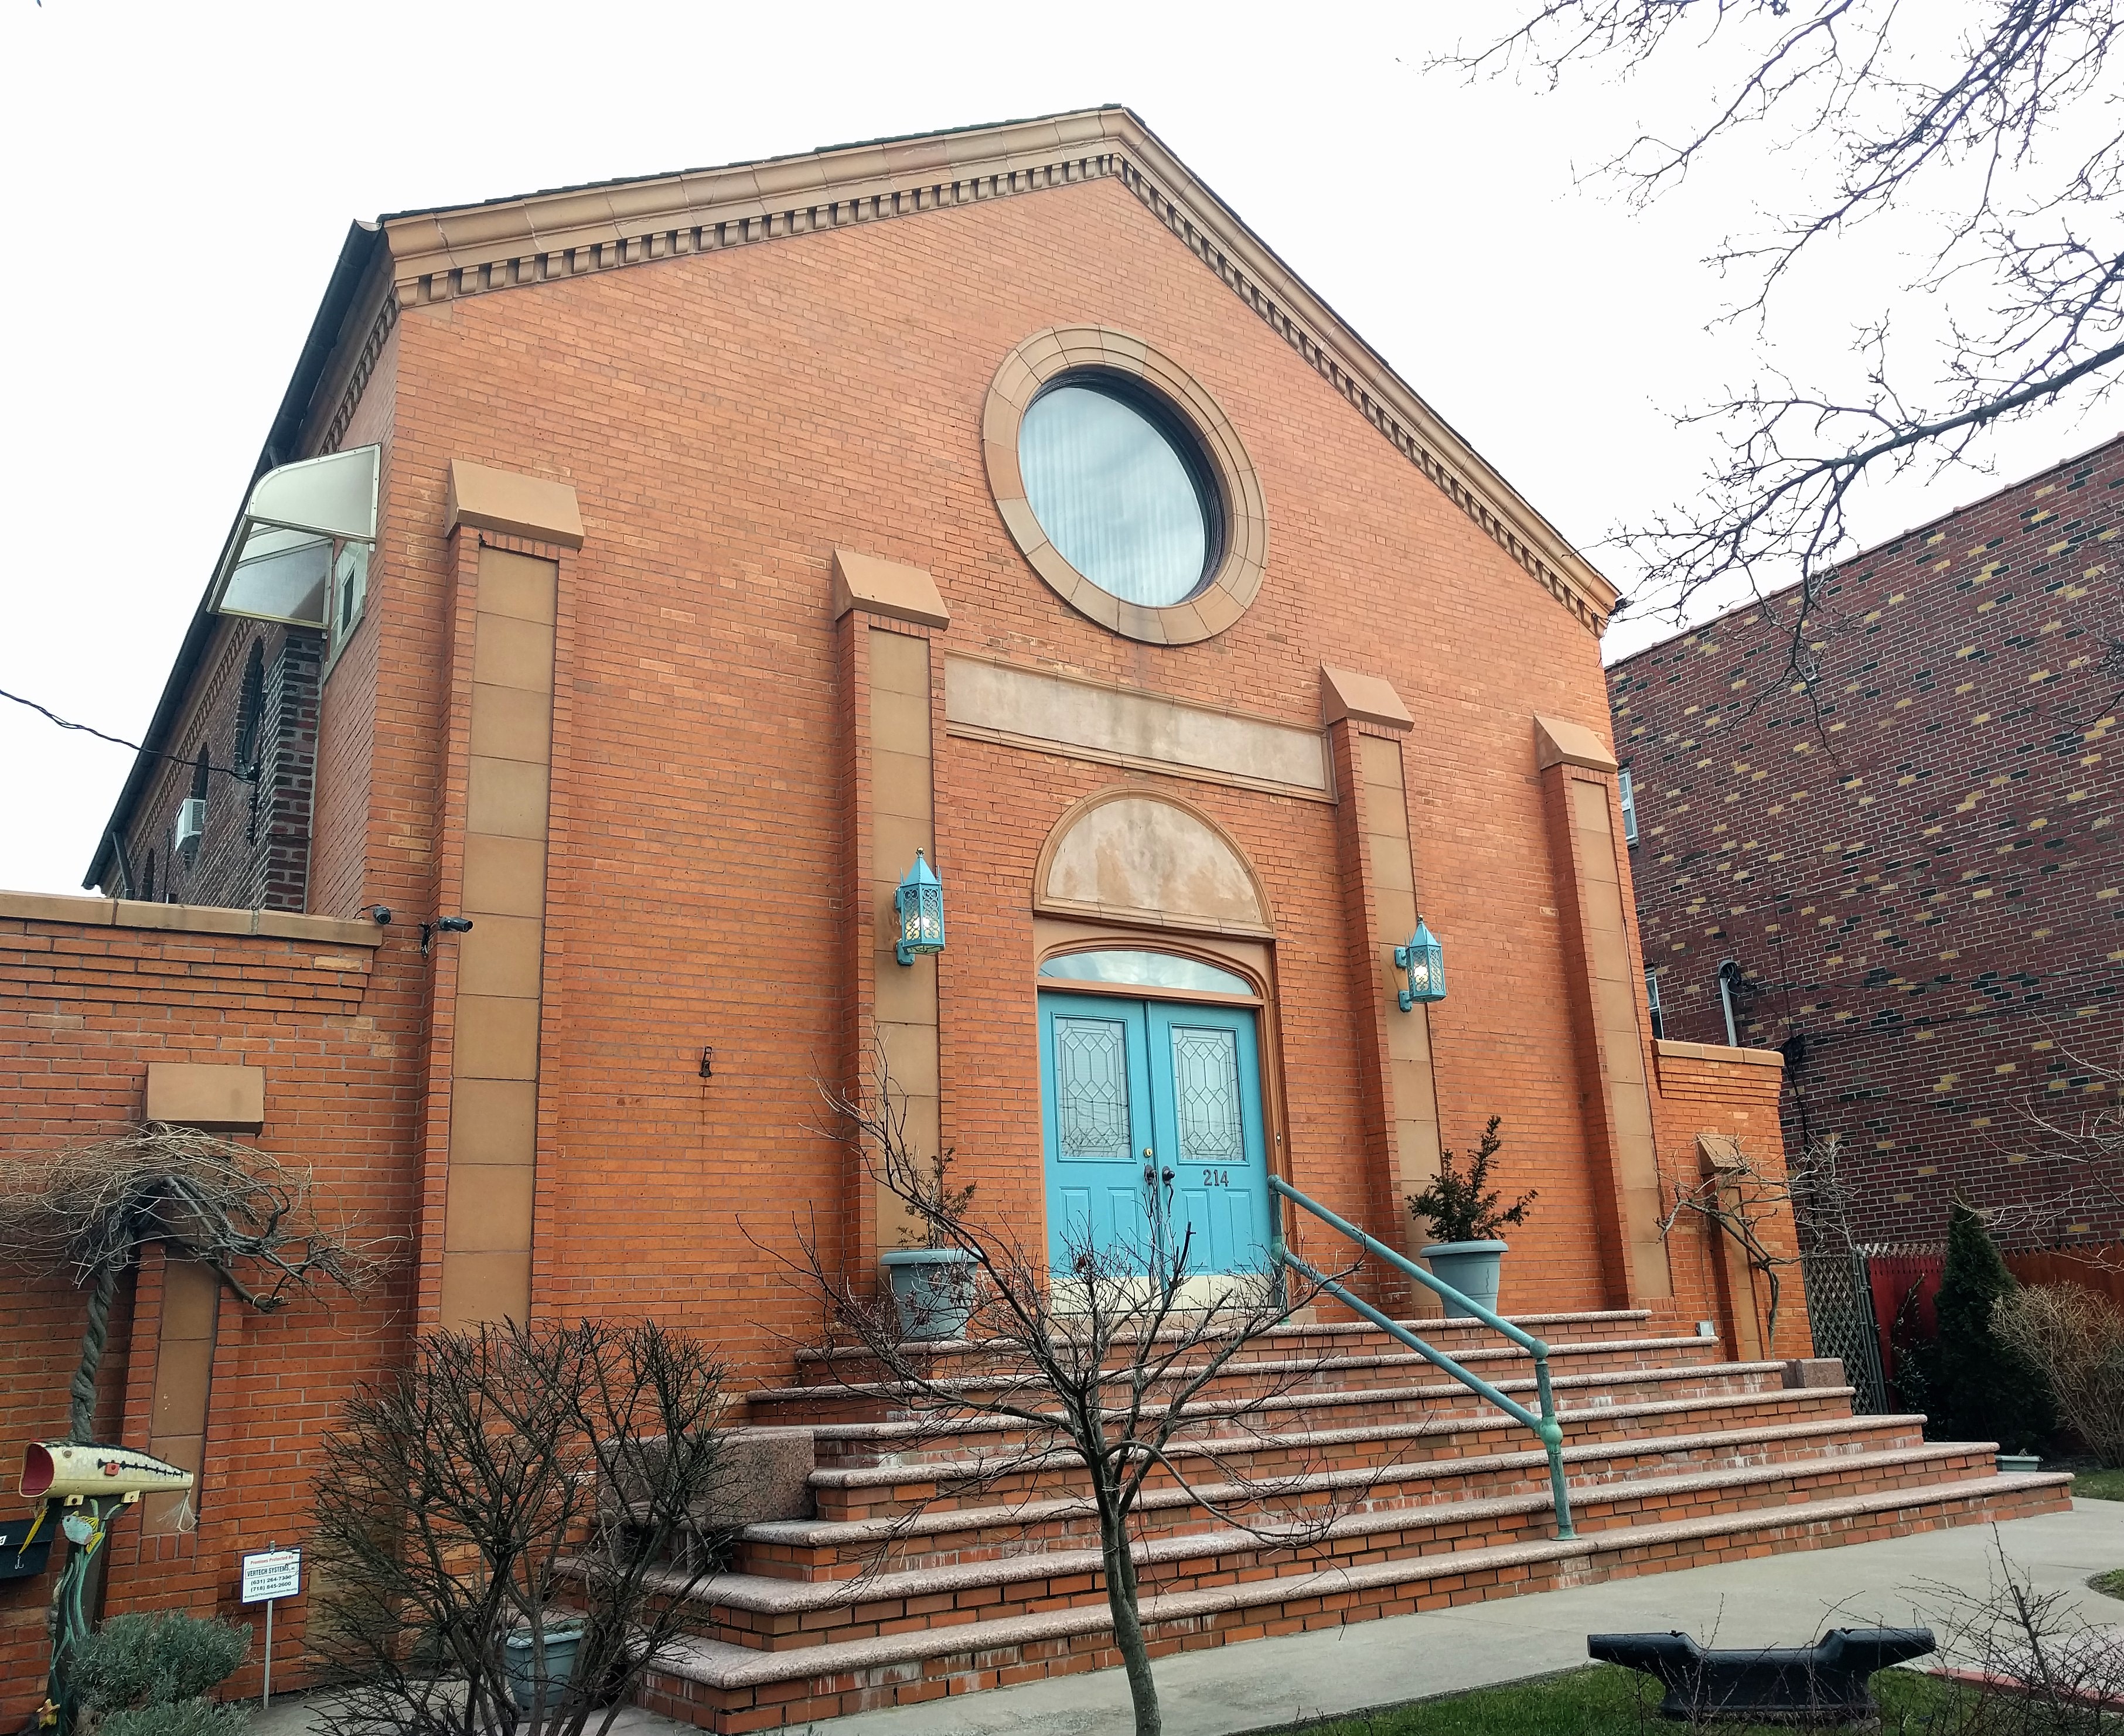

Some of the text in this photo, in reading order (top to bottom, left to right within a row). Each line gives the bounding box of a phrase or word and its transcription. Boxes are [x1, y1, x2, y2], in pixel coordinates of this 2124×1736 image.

[1203, 1169, 1229, 1187] 214
[247, 1568, 268, 1577] VERTECH
[267, 1575, 292, 1583] 264-7330
